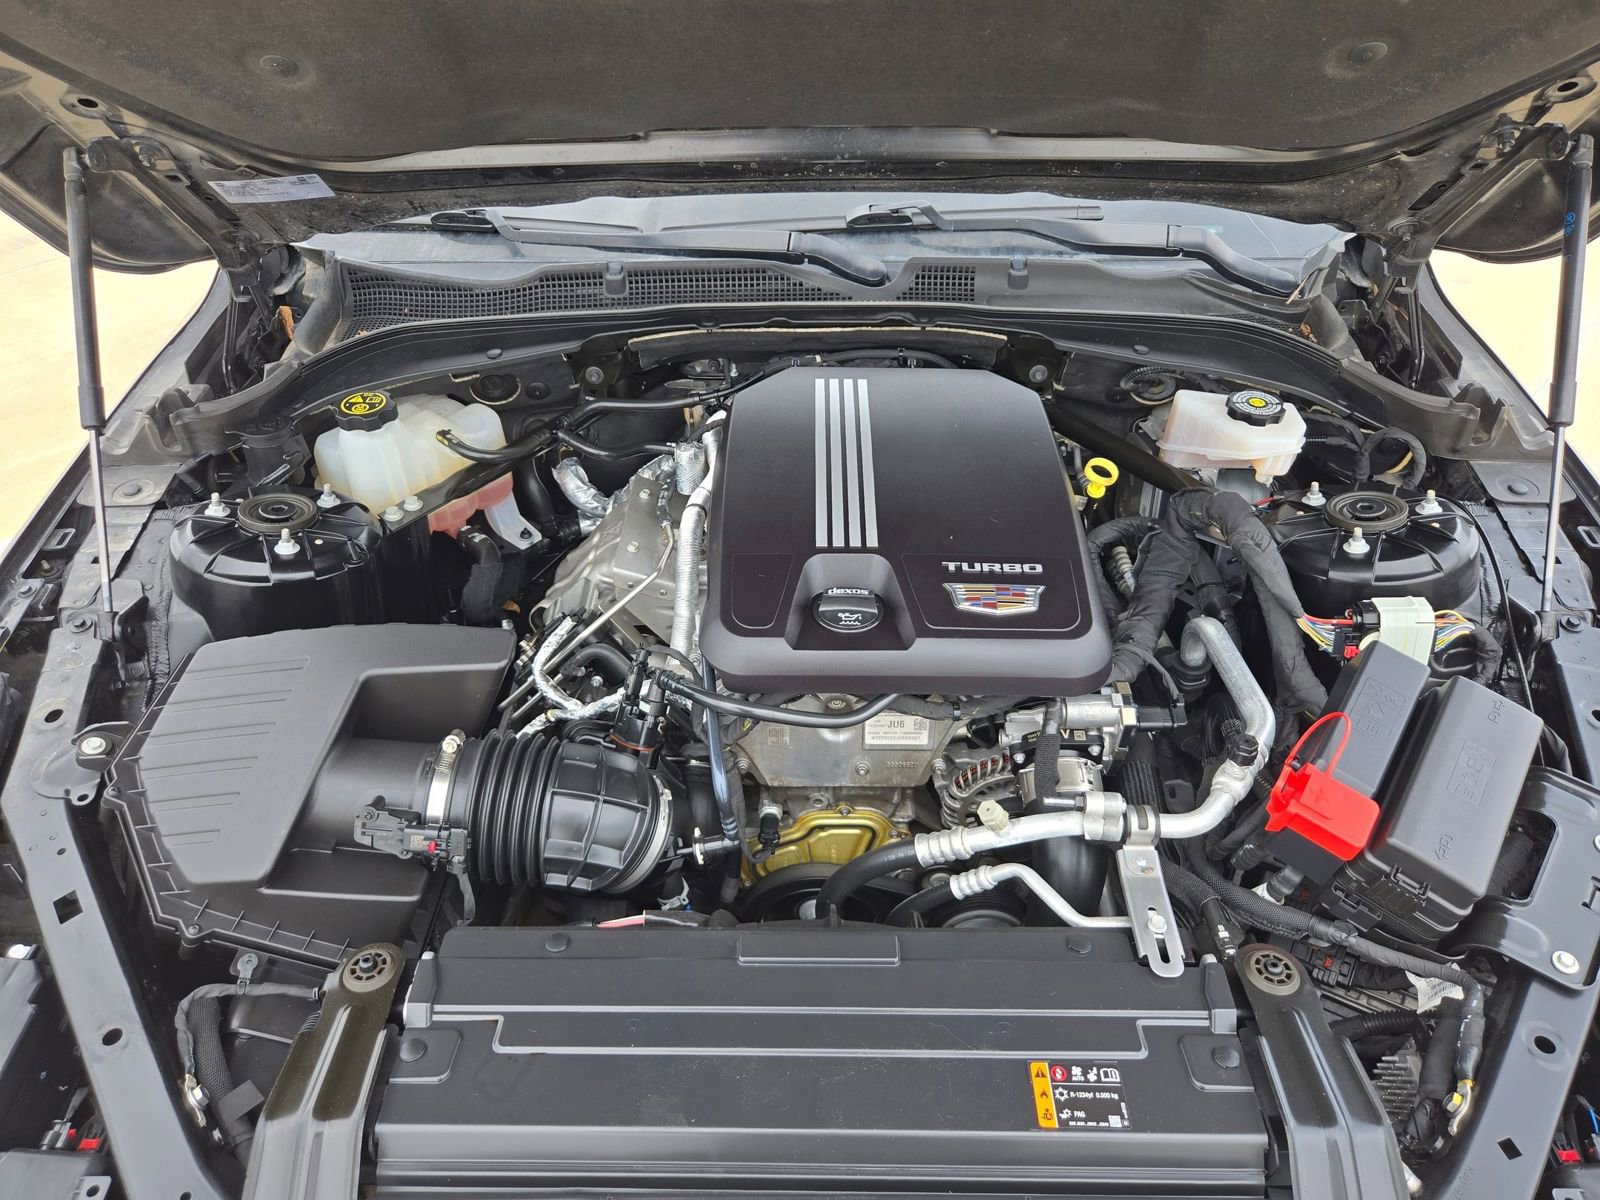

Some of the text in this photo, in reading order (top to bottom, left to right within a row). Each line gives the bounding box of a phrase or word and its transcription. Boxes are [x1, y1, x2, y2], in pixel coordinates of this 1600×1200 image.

[941, 561, 1044, 574] TURBO
[827, 587, 870, 595] dexos
[887, 720, 905, 728] JU6
[1070, 1091, 1093, 1099] R-1234yf
[1111, 1092, 1118, 1100] kg
